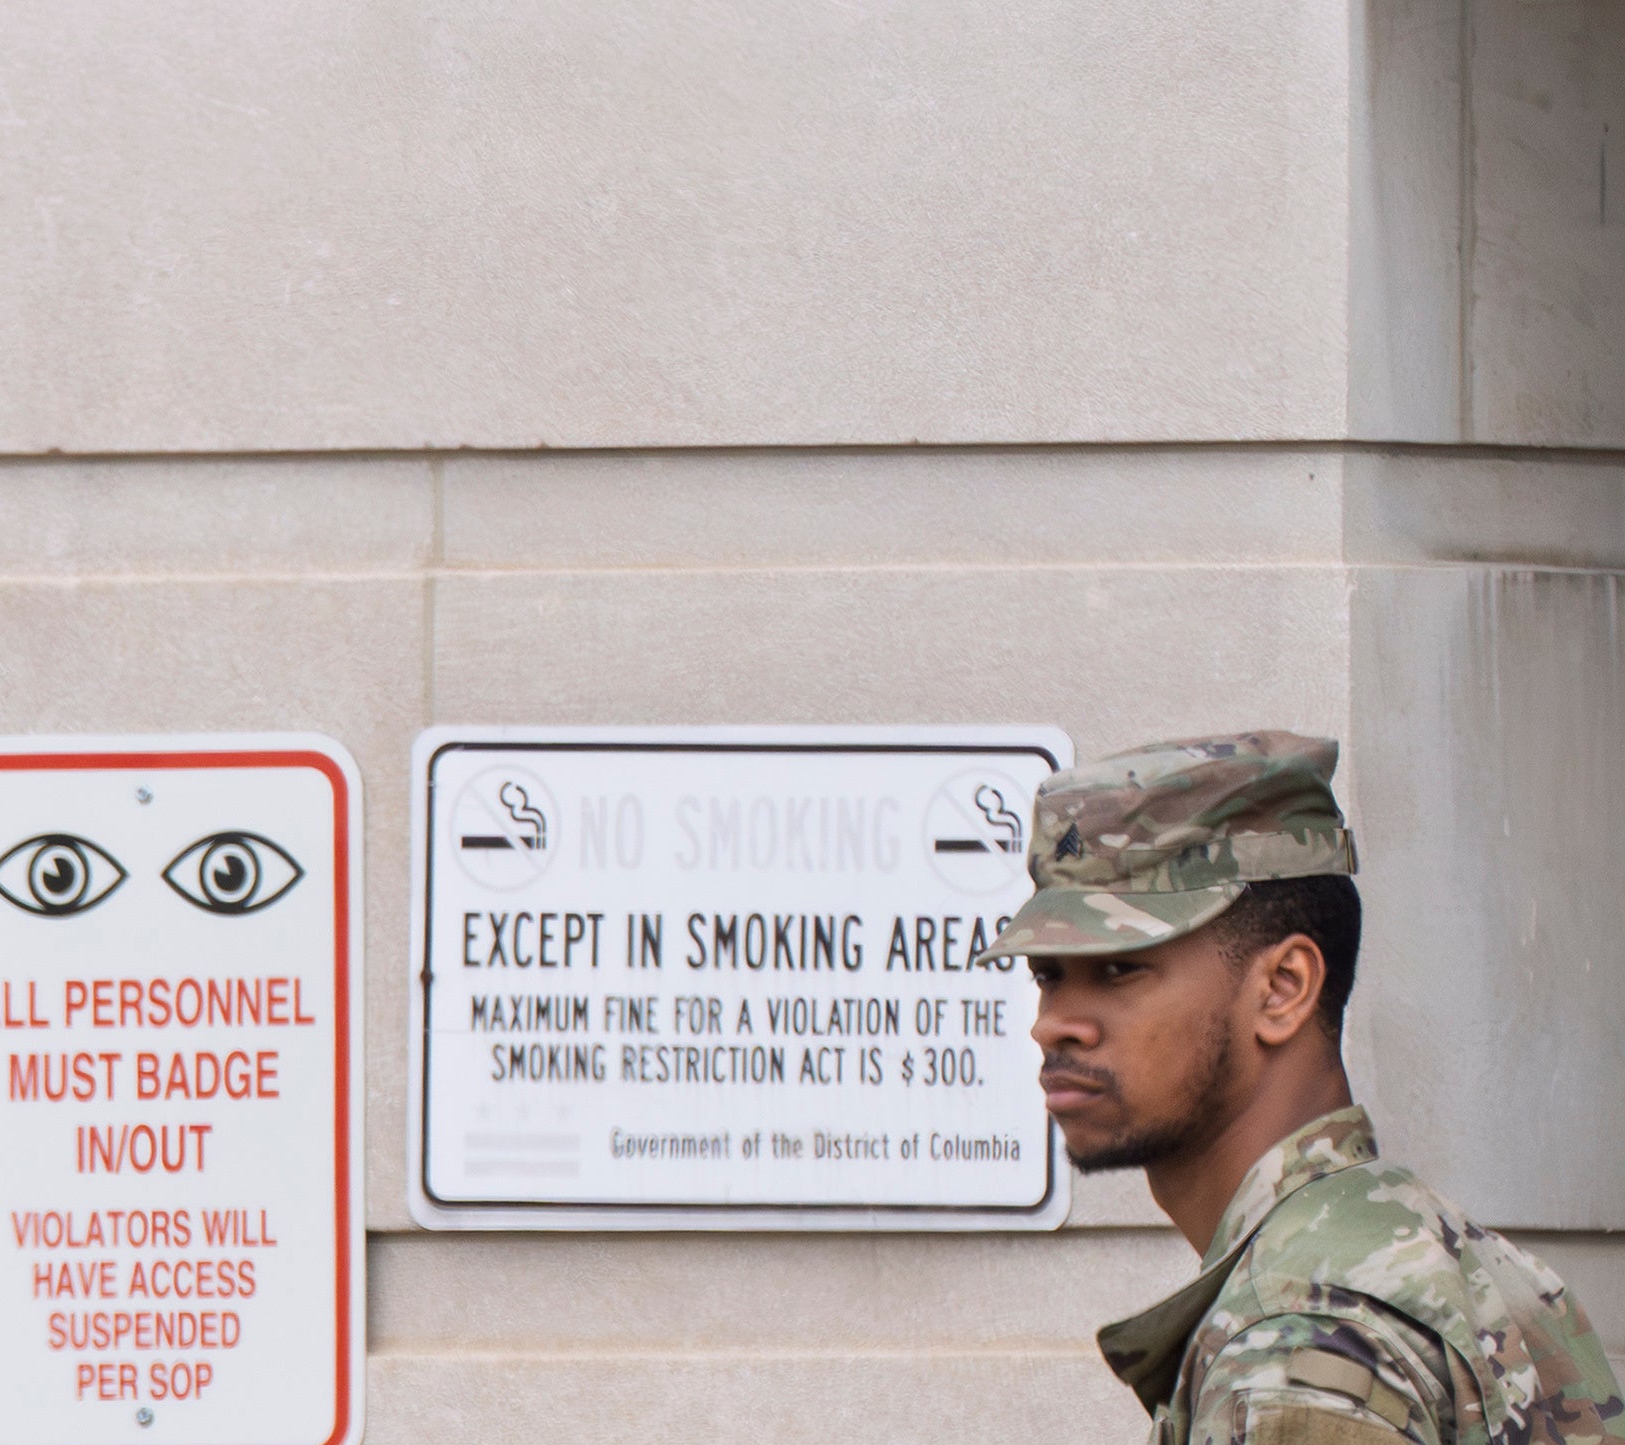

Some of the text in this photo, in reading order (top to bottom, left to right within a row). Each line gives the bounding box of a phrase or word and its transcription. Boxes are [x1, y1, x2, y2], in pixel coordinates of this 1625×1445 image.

[579, 794, 900, 873] NO SMOKING
[462, 911, 605, 969] EXCEPT
[626, 912, 663, 969] IN
[686, 912, 863, 972] SMOKING
[64, 977, 316, 1028] PERSONNEL
[470, 994, 1007, 1037] MAXIMUM FINE FOR A VIOLATION OF THE
[8, 1050, 280, 1102] MUST BADGE
[491, 1043, 606, 1083] SMOKING
[621, 1045, 785, 1084] RESTRICTION
[799, 1046, 846, 1085] ACT
[860, 1047, 883, 1086] IS
[76, 1123, 213, 1175] IN/OUT
[611, 1126, 1021, 1161] Government of the District of Columbia
[11, 1208, 278, 1249] VIOLATORS WILL
[32, 1259, 256, 1299] HAVE ACCESS
[48, 1310, 241, 1351] SUSPENDED
[76, 1362, 214, 1401] PER SOP
